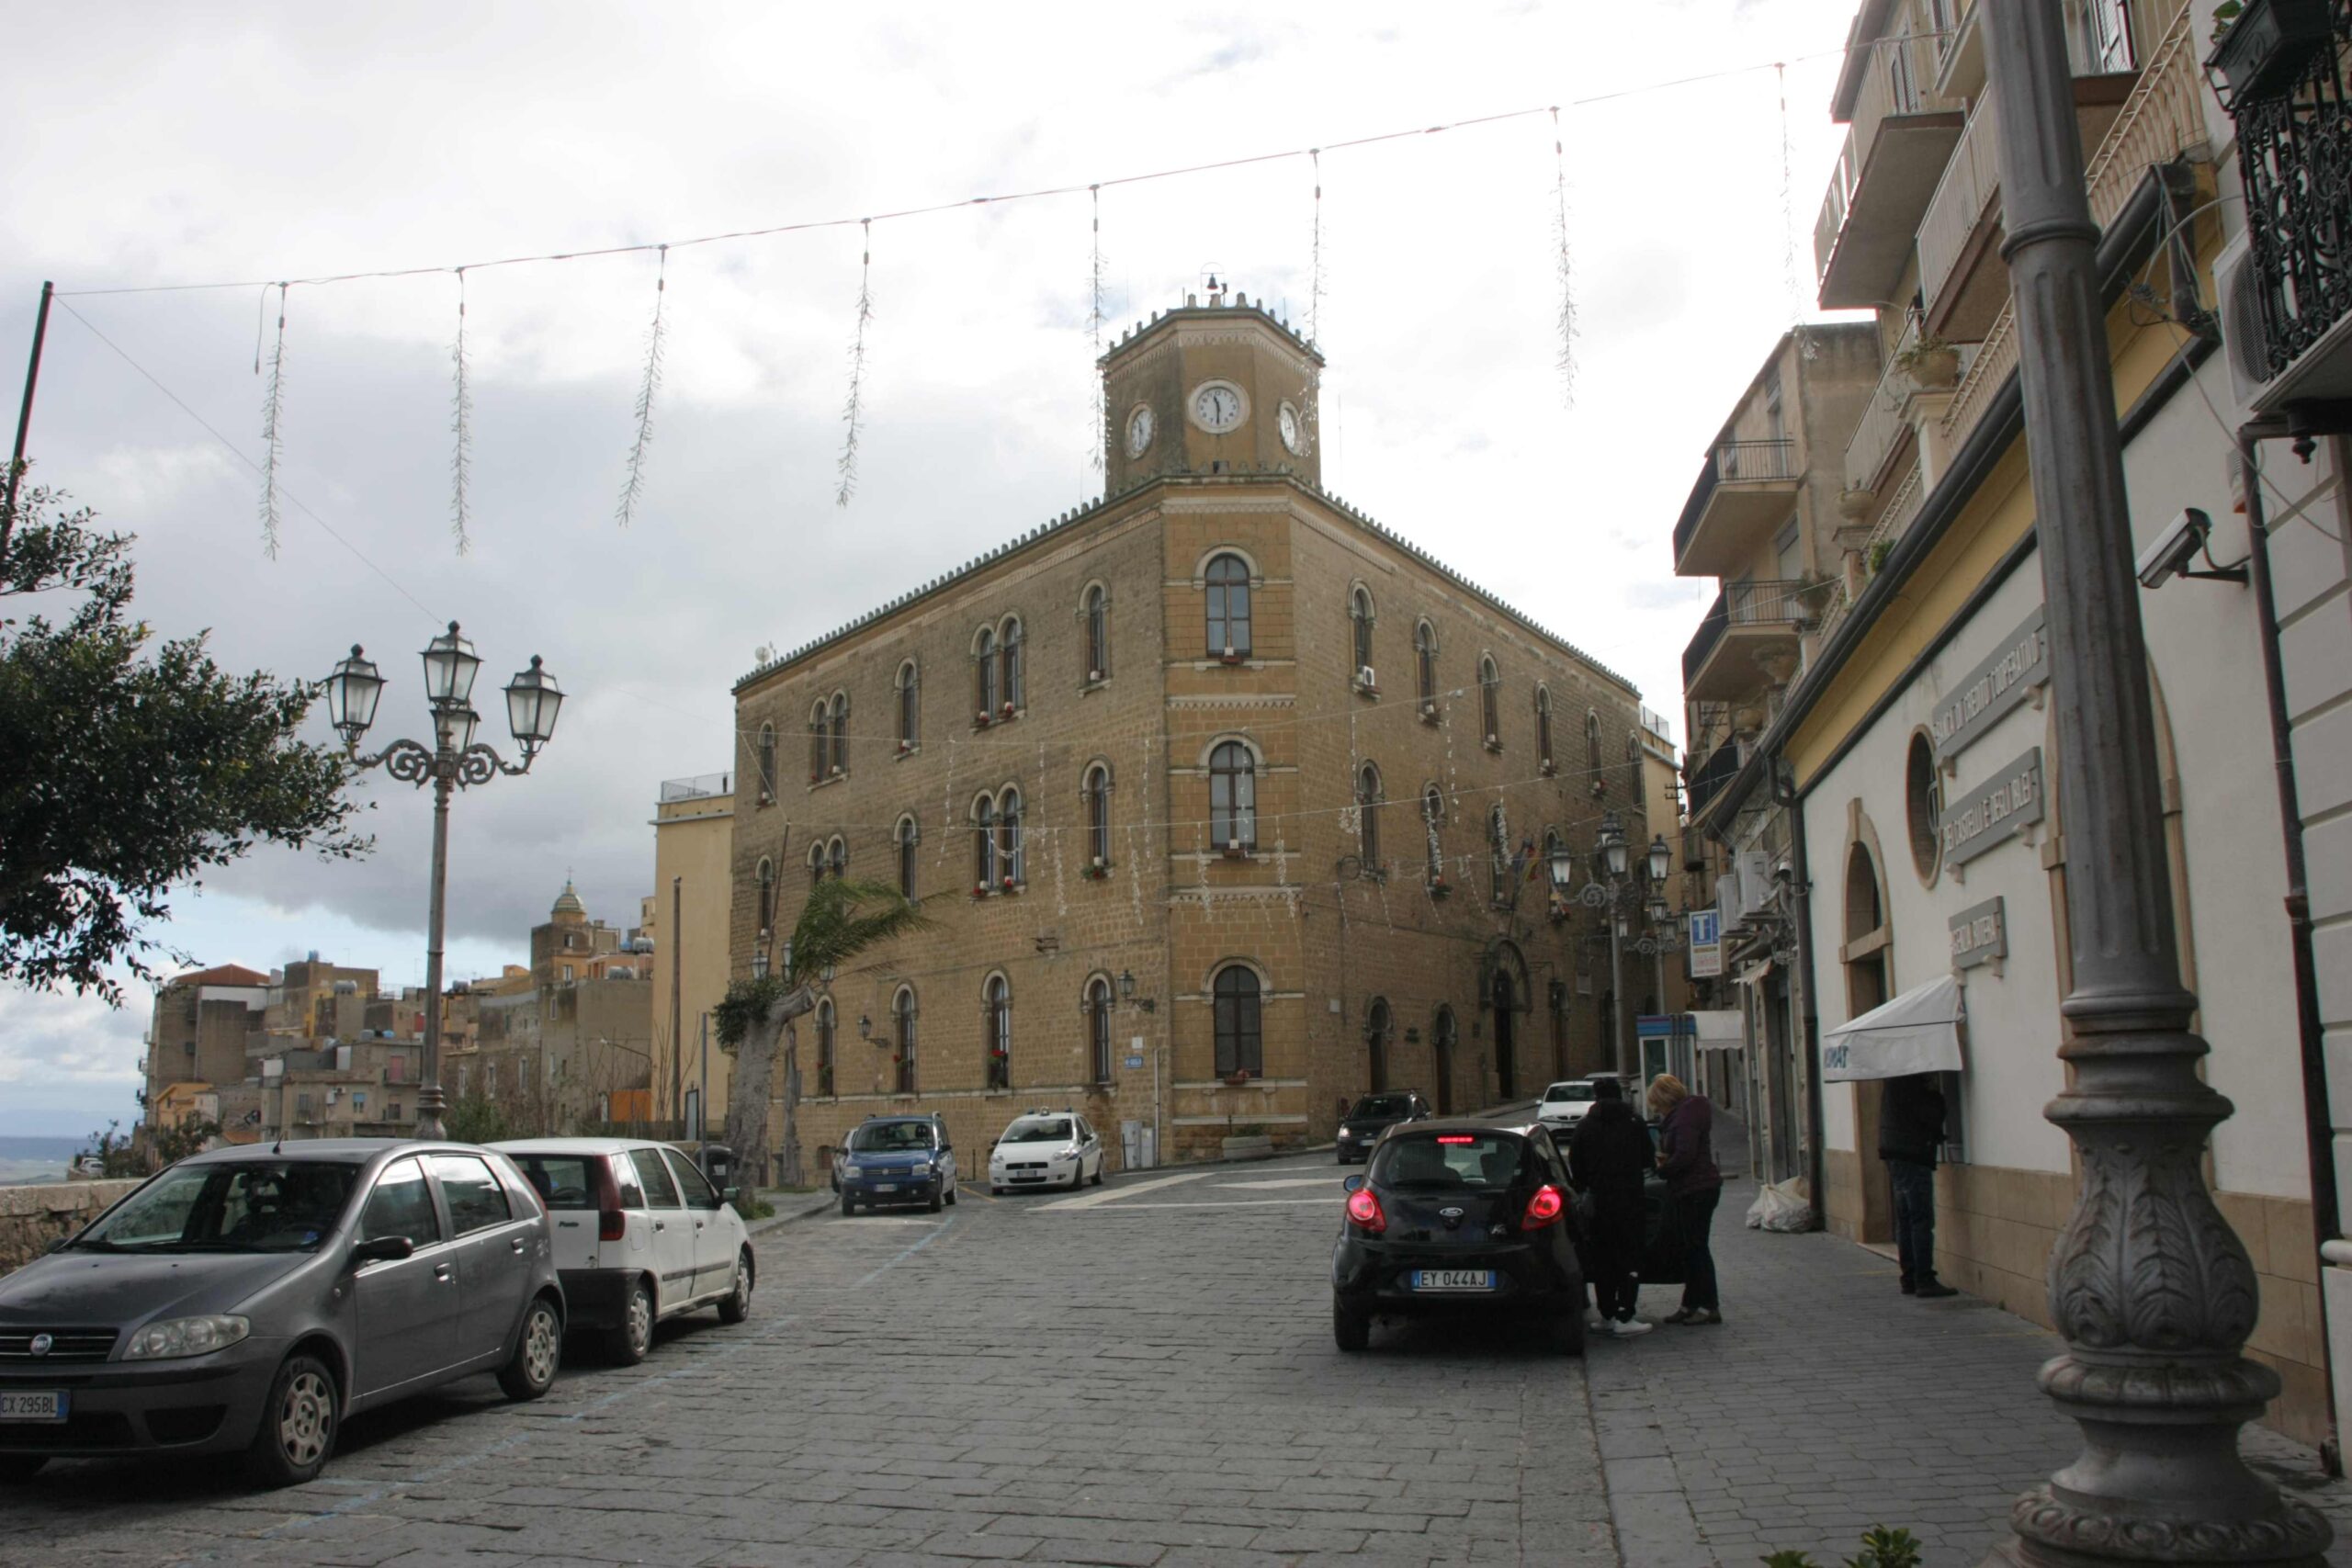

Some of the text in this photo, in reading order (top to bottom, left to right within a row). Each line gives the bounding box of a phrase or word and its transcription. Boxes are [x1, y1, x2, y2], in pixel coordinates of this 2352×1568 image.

[1964, 677, 1992, 724] CREDITO
[1991, 631, 2041, 699] COOPERATIVO
[1955, 802, 1984, 846] CASTELLI
[1989, 784, 2013, 824] DEGLI
[1421, 1272, 1487, 1286] EY 044AJ
[19, 1397, 57, 1413] 295BL
